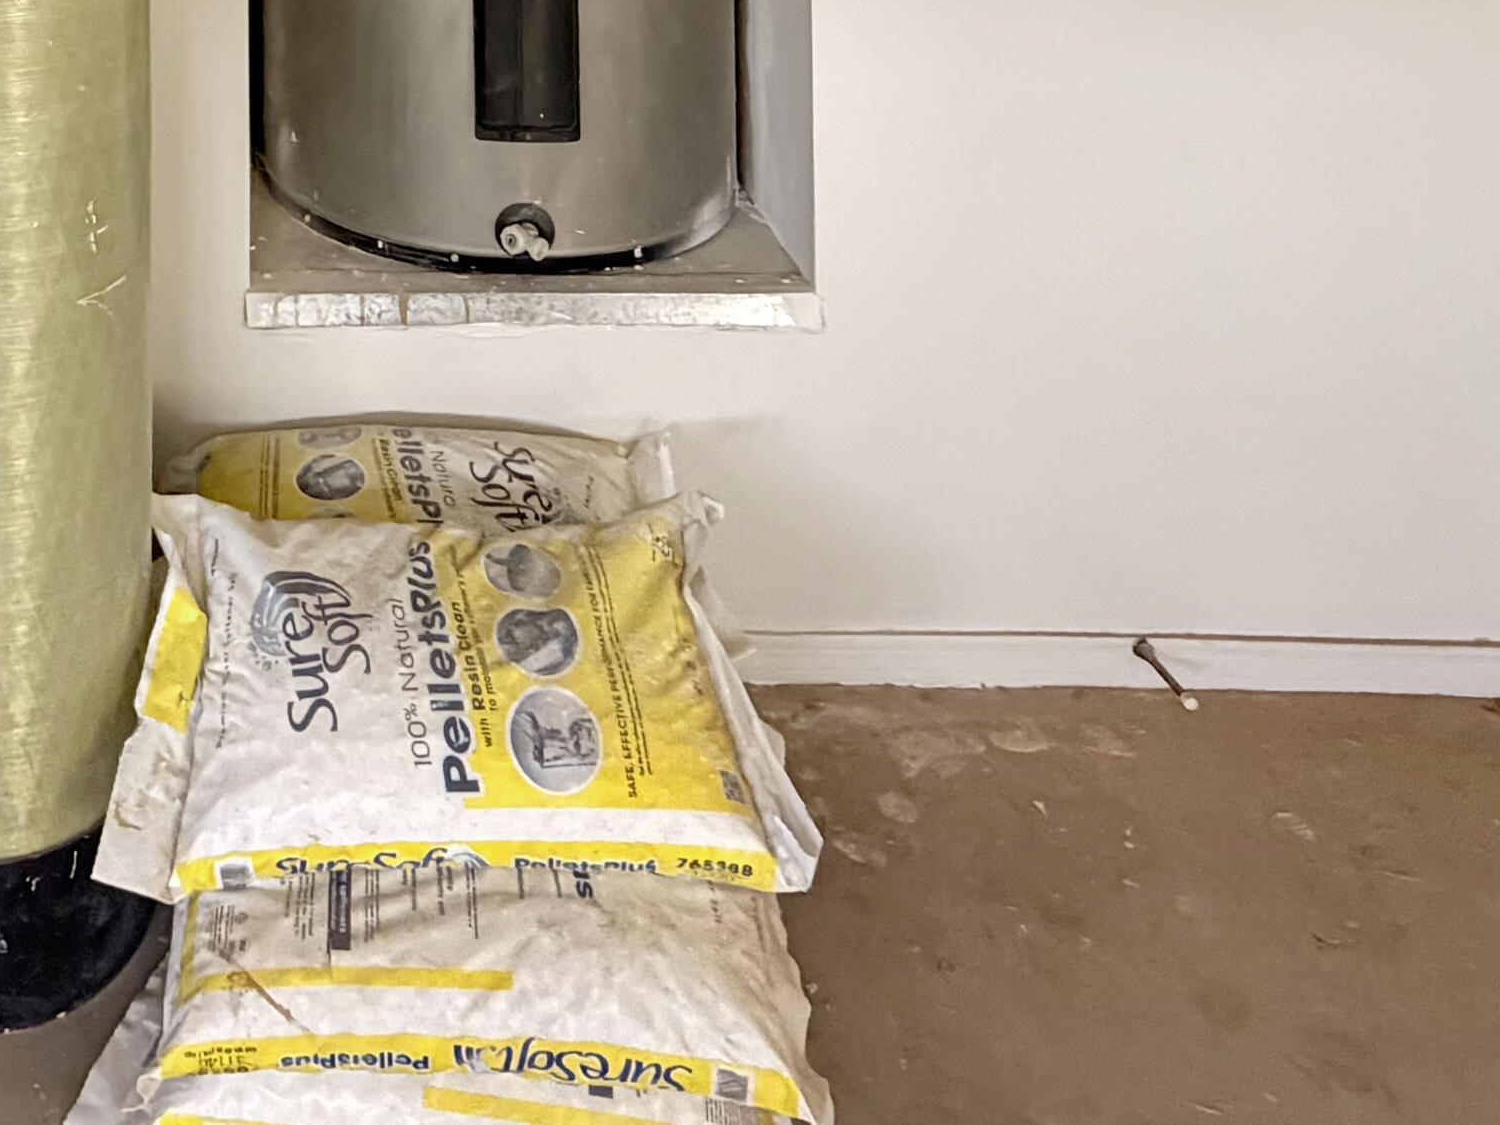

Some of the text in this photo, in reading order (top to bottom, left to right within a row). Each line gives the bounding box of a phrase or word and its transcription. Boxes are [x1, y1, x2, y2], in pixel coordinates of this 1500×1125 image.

[392, 428, 444, 524] elletsPl
[469, 461, 541, 527] Soft
[493, 440, 553, 513] Sure
[282, 612, 339, 733] Sure
[301, 595, 374, 675] Soft
[386, 597, 432, 766] 100% Natural
[407, 540, 481, 793] PelletsPlus
[451, 601, 493, 748] with Resin Clean
[488, 698, 499, 711] to
